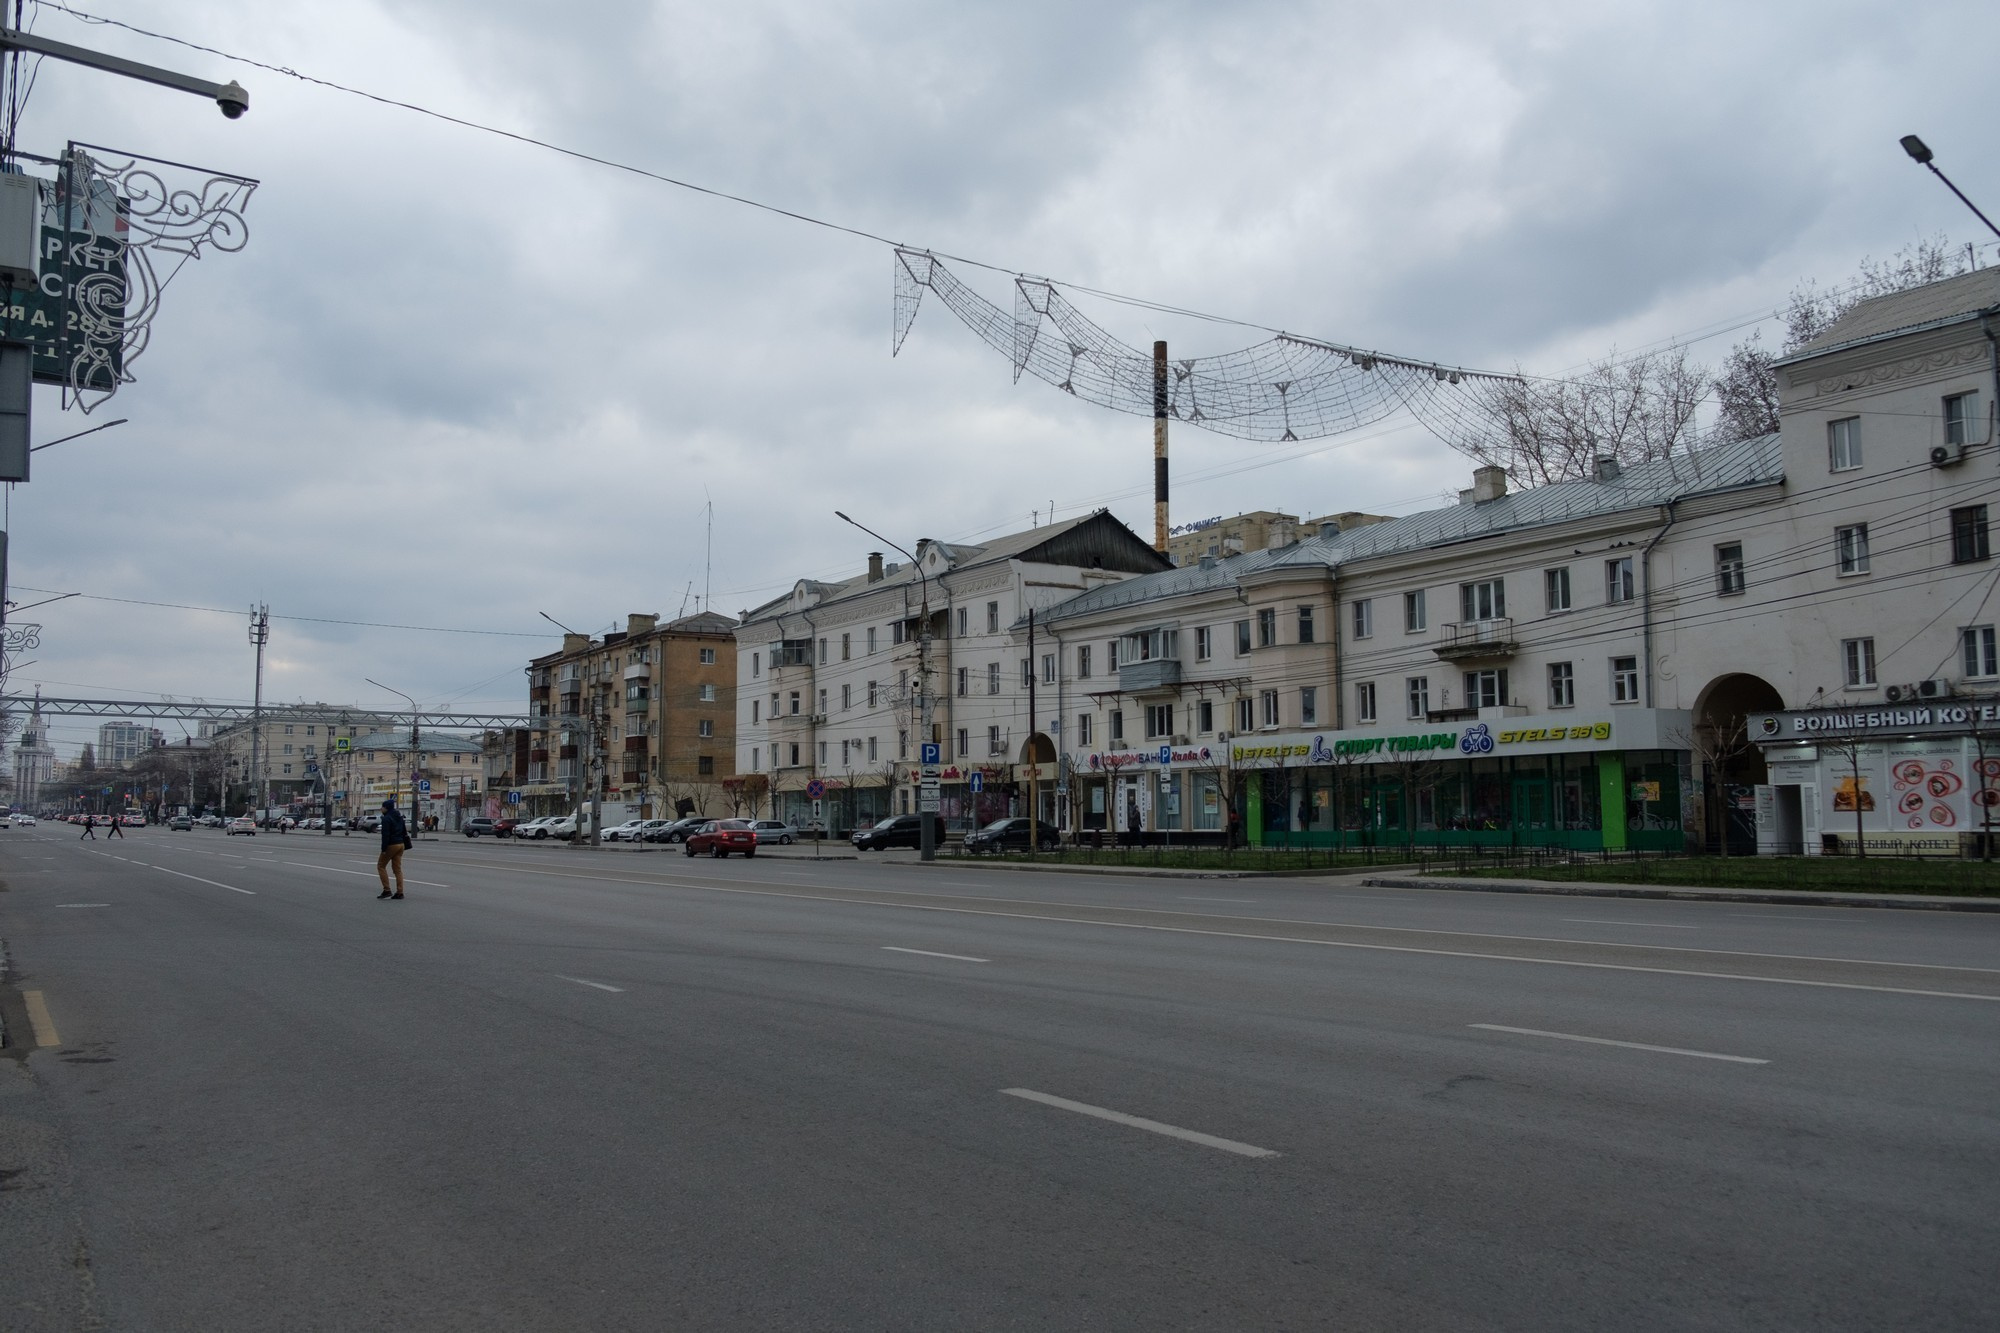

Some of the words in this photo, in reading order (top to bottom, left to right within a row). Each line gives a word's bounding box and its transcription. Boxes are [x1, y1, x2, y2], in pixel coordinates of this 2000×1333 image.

[40, 236, 115, 272] РКЕТ
[1185, 515, 1222, 533] ФИНИСТ
[1793, 707, 1932, 732] ВОЛШЕБНЫЙ
[1334, 738, 1385, 755] СПОРТ
[1387, 733, 1457, 752] ТОВАРЫ
[1499, 728, 1567, 743] STELS
[1171, 750, 1198, 762] Халва
[1242, 746, 1292, 759] STELS
